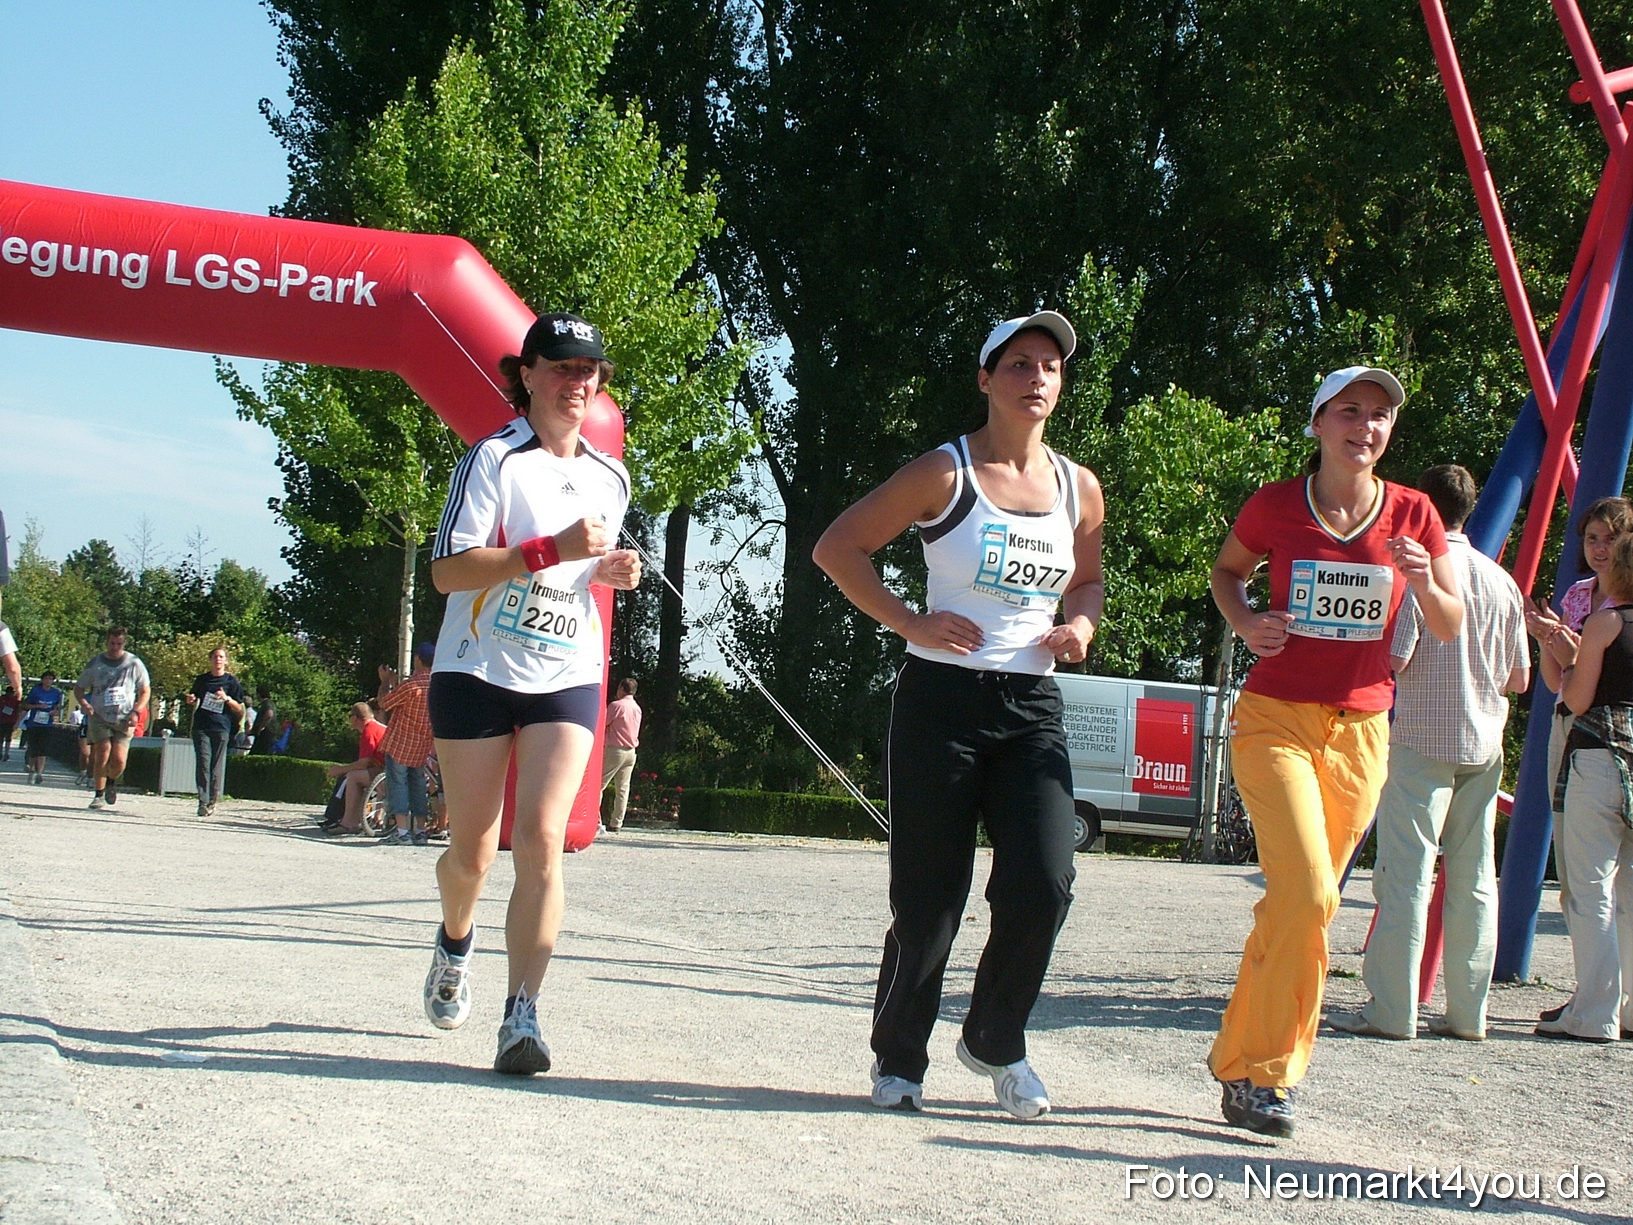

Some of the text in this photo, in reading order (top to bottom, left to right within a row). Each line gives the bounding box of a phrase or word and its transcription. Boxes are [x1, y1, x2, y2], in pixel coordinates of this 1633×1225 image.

[0, 233, 378, 307] egung LGS-Park
[1009, 533, 1053, 554] Kerstin
[987, 551, 998, 565] D
[1004, 560, 1067, 588] 2977
[1317, 570, 1369, 588] Kathrin
[507, 594, 519, 608] D
[531, 581, 576, 604] Irmgard
[1296, 588, 1307, 600] D
[1316, 596, 1382, 620] 3068
[522, 607, 577, 638] 2200
[1063, 713, 1118, 725] DSCHLINGEN
[1064, 722, 1117, 734] EBEBÄNDER
[1066, 732, 1117, 743] LAGKETTEN
[1069, 741, 1116, 753] DESTRICKE
[1134, 754, 1186, 783] Braun
